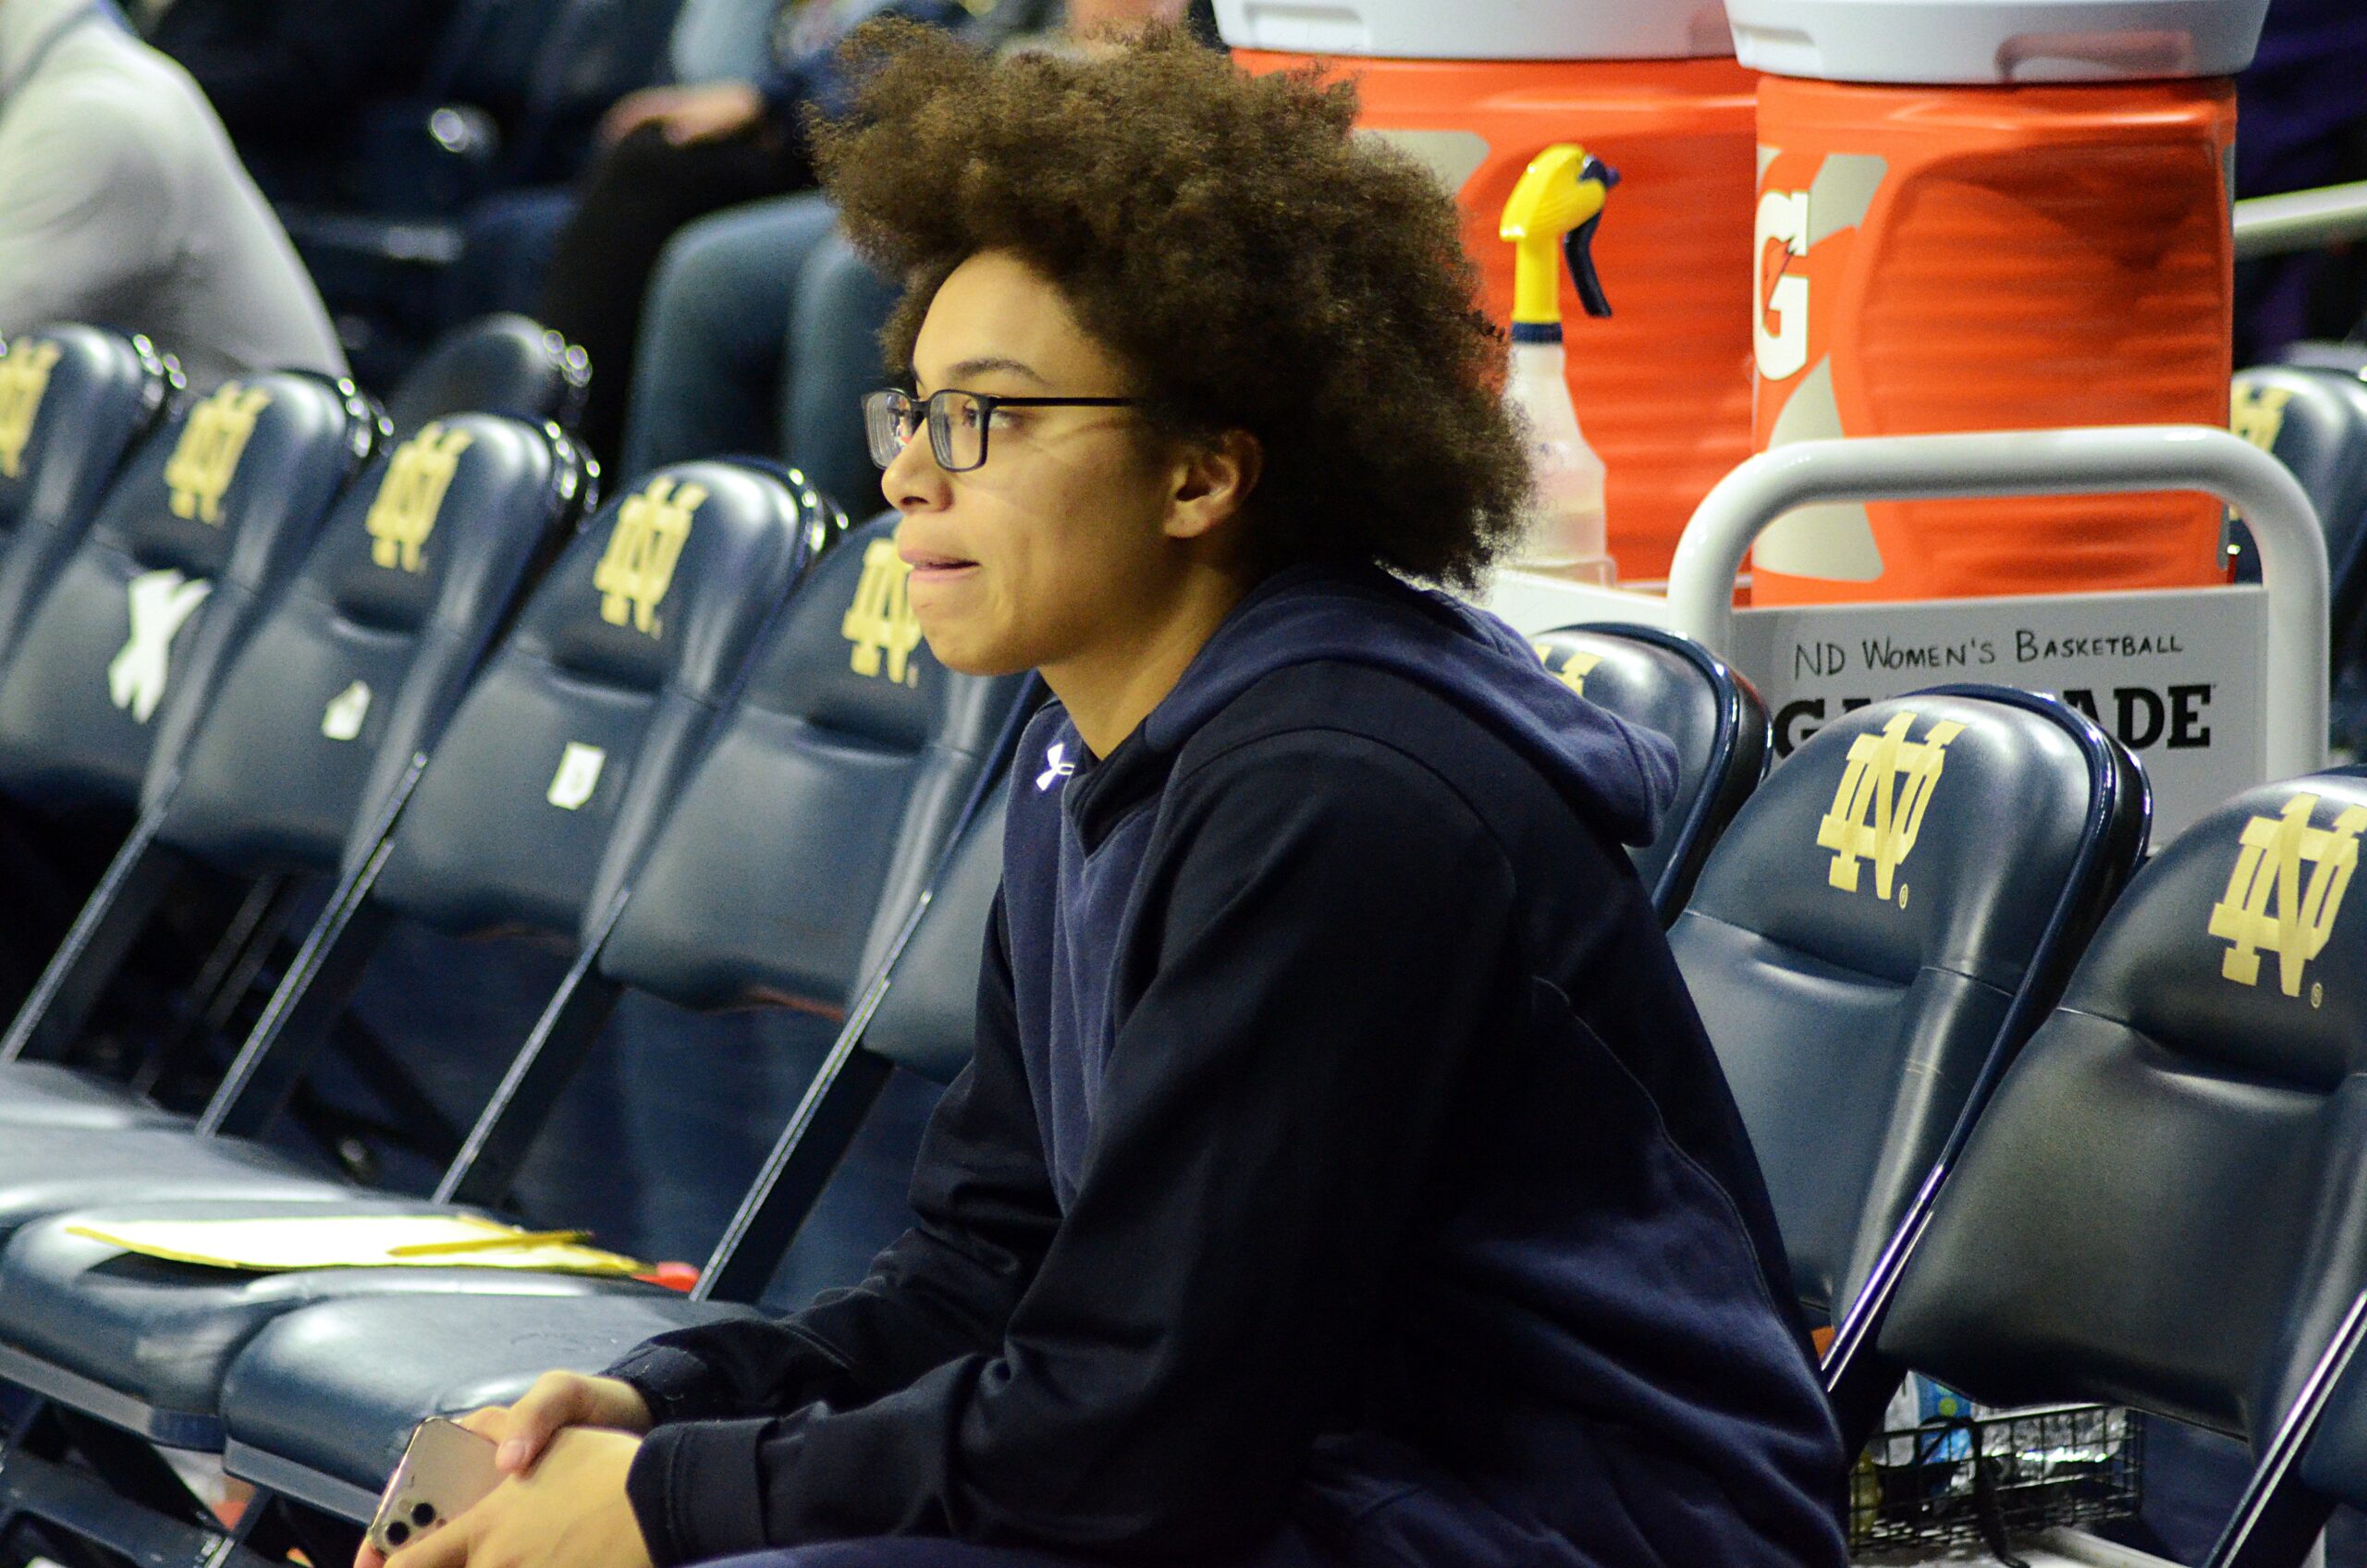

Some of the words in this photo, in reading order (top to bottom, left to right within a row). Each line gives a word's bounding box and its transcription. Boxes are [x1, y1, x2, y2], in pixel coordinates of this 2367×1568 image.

[1795, 642, 1846, 680] ND
[1862, 635, 1995, 670] WOMEN'S
[2016, 628, 2183, 664] BASKETBALL
